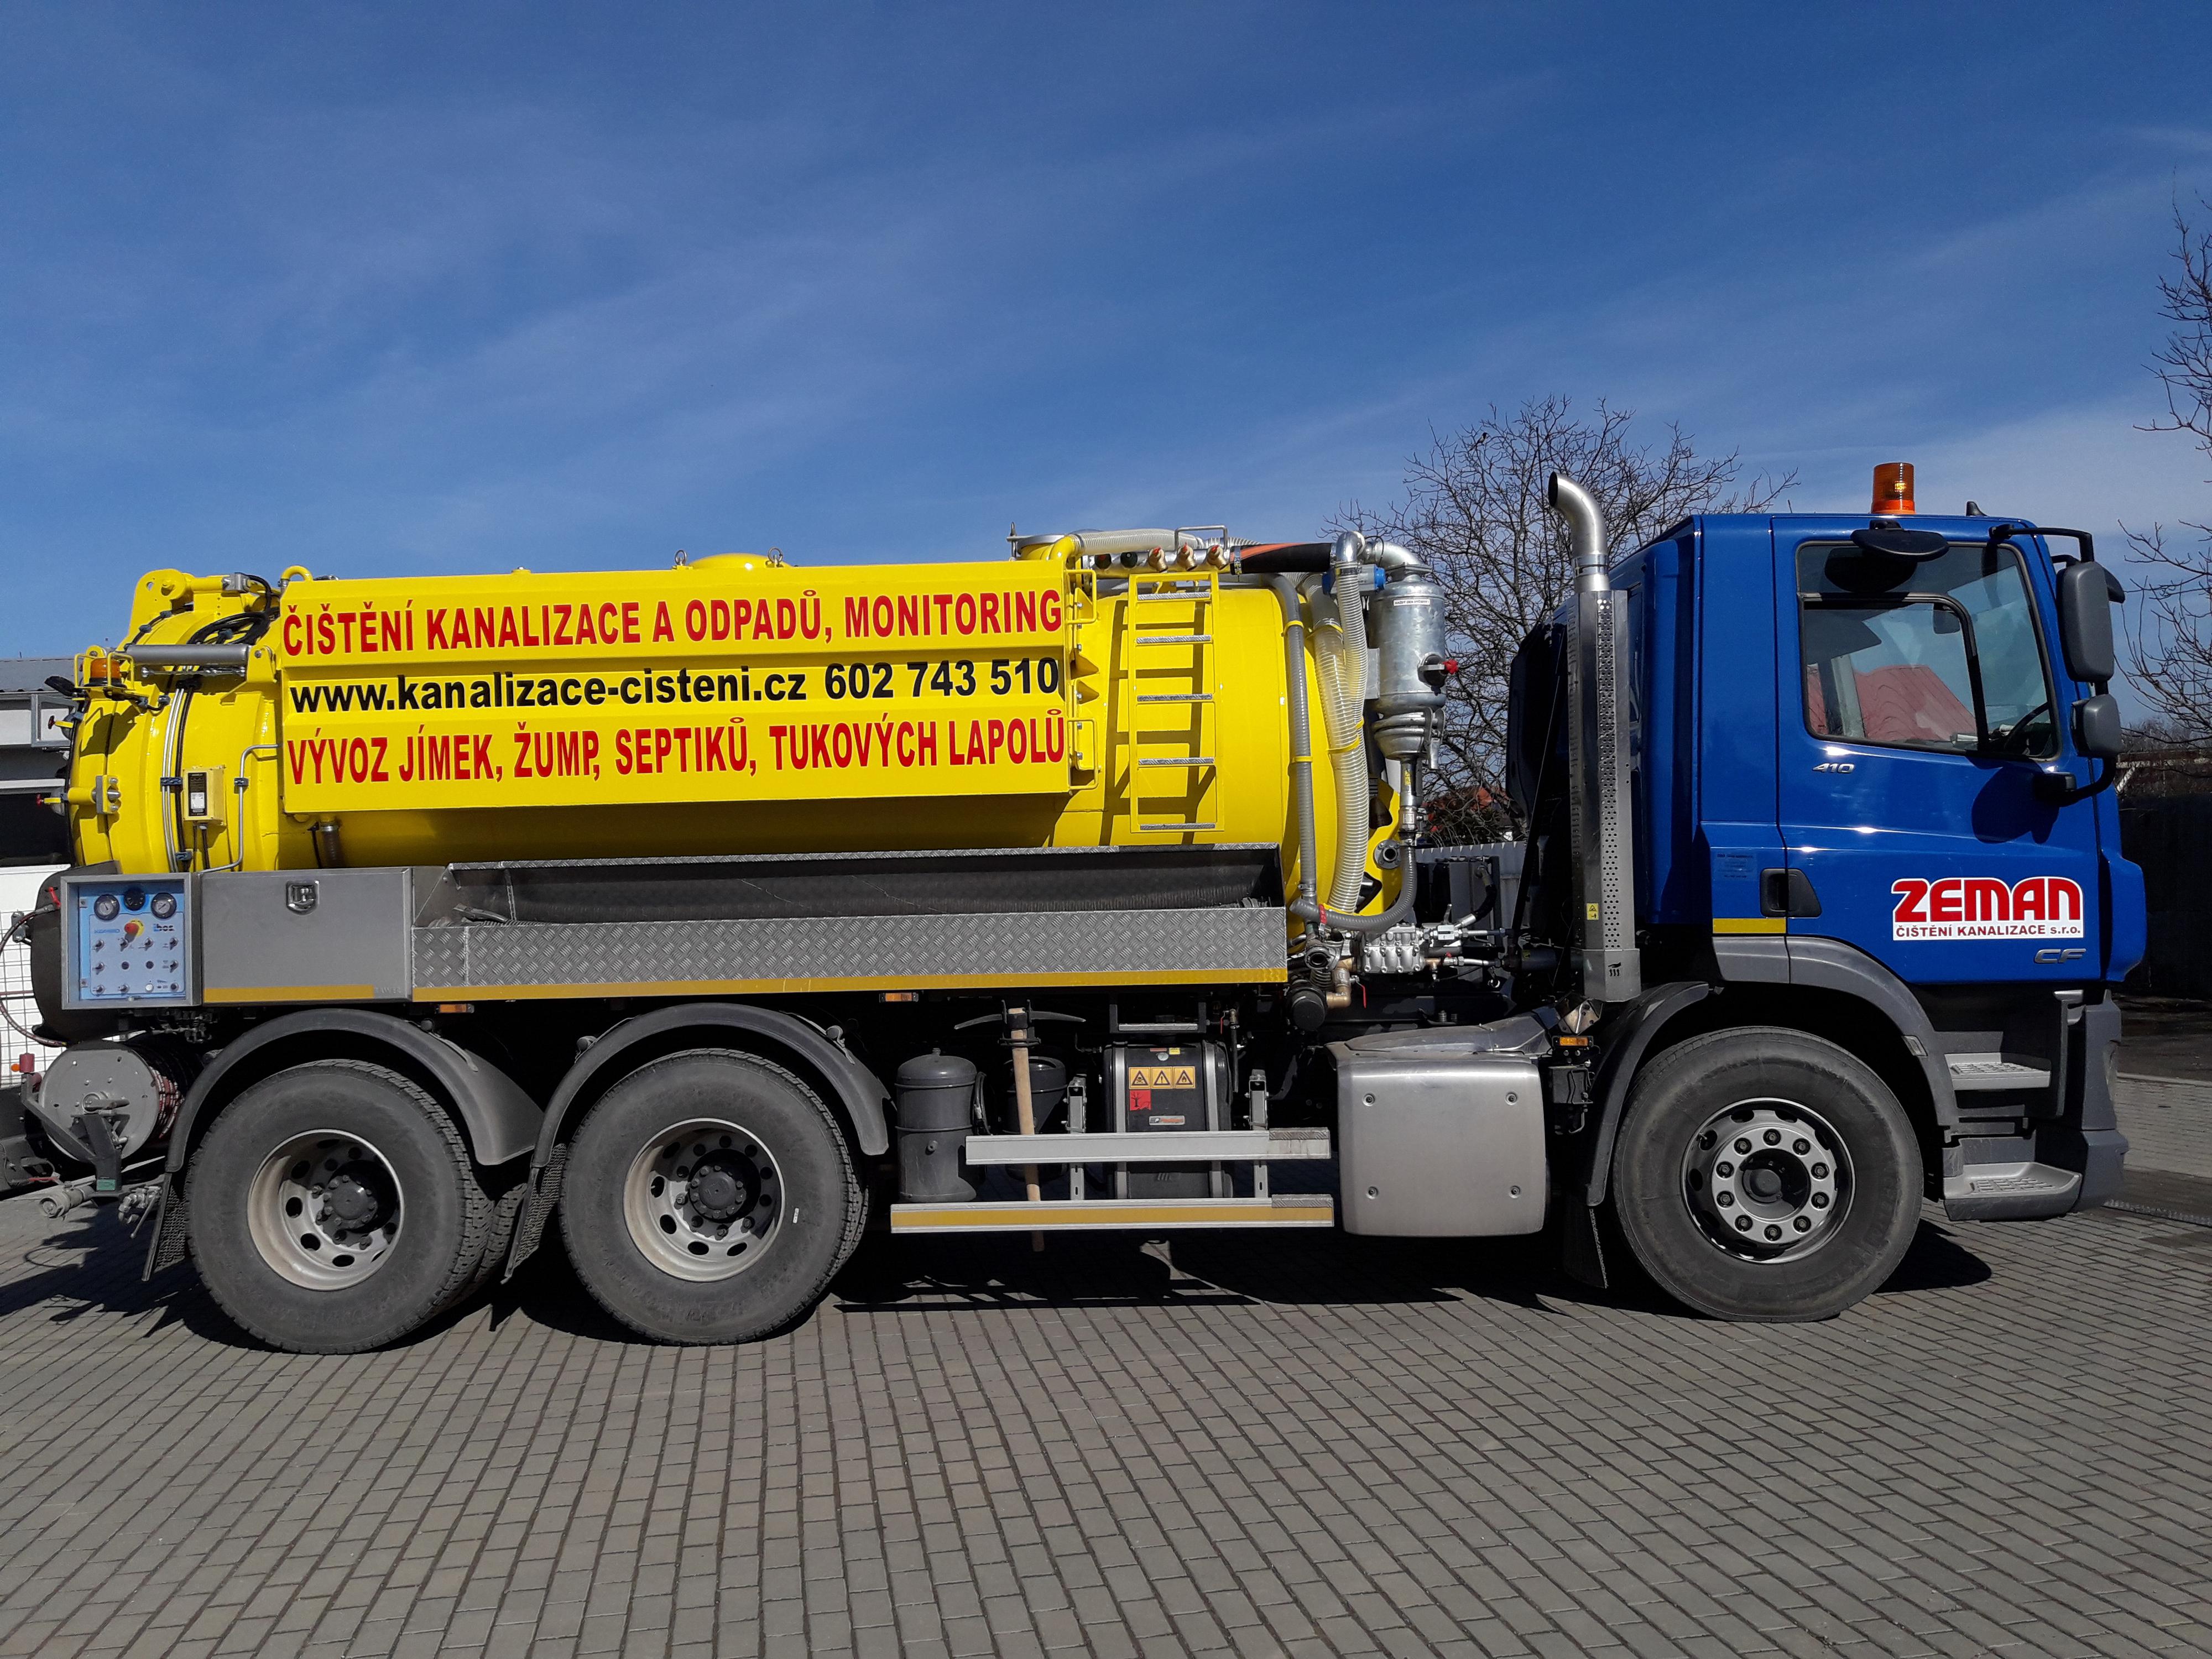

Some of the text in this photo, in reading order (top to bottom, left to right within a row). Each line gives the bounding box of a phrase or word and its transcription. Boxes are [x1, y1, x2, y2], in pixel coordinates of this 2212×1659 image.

[283, 589, 1062, 656] ČIŠTĚNÍ KANALIZACE A ODPADŮ, MONITORING
[290, 658, 1059, 713] www.kanalizace-cisteni.cz 602 743 510
[287, 708, 1065, 785] VÝVOZ JÍMEK, ŽUMP, SEPTIKŮ, TUKOVÝCH LAPOLŮ
[1812, 763, 1854, 773] 410
[1892, 877, 2081, 922] ZEMAN
[1896, 924, 2081, 937] ČIŠTĚNÍ KANALIZACE s.r.o.
[2033, 948, 2086, 963] CF
